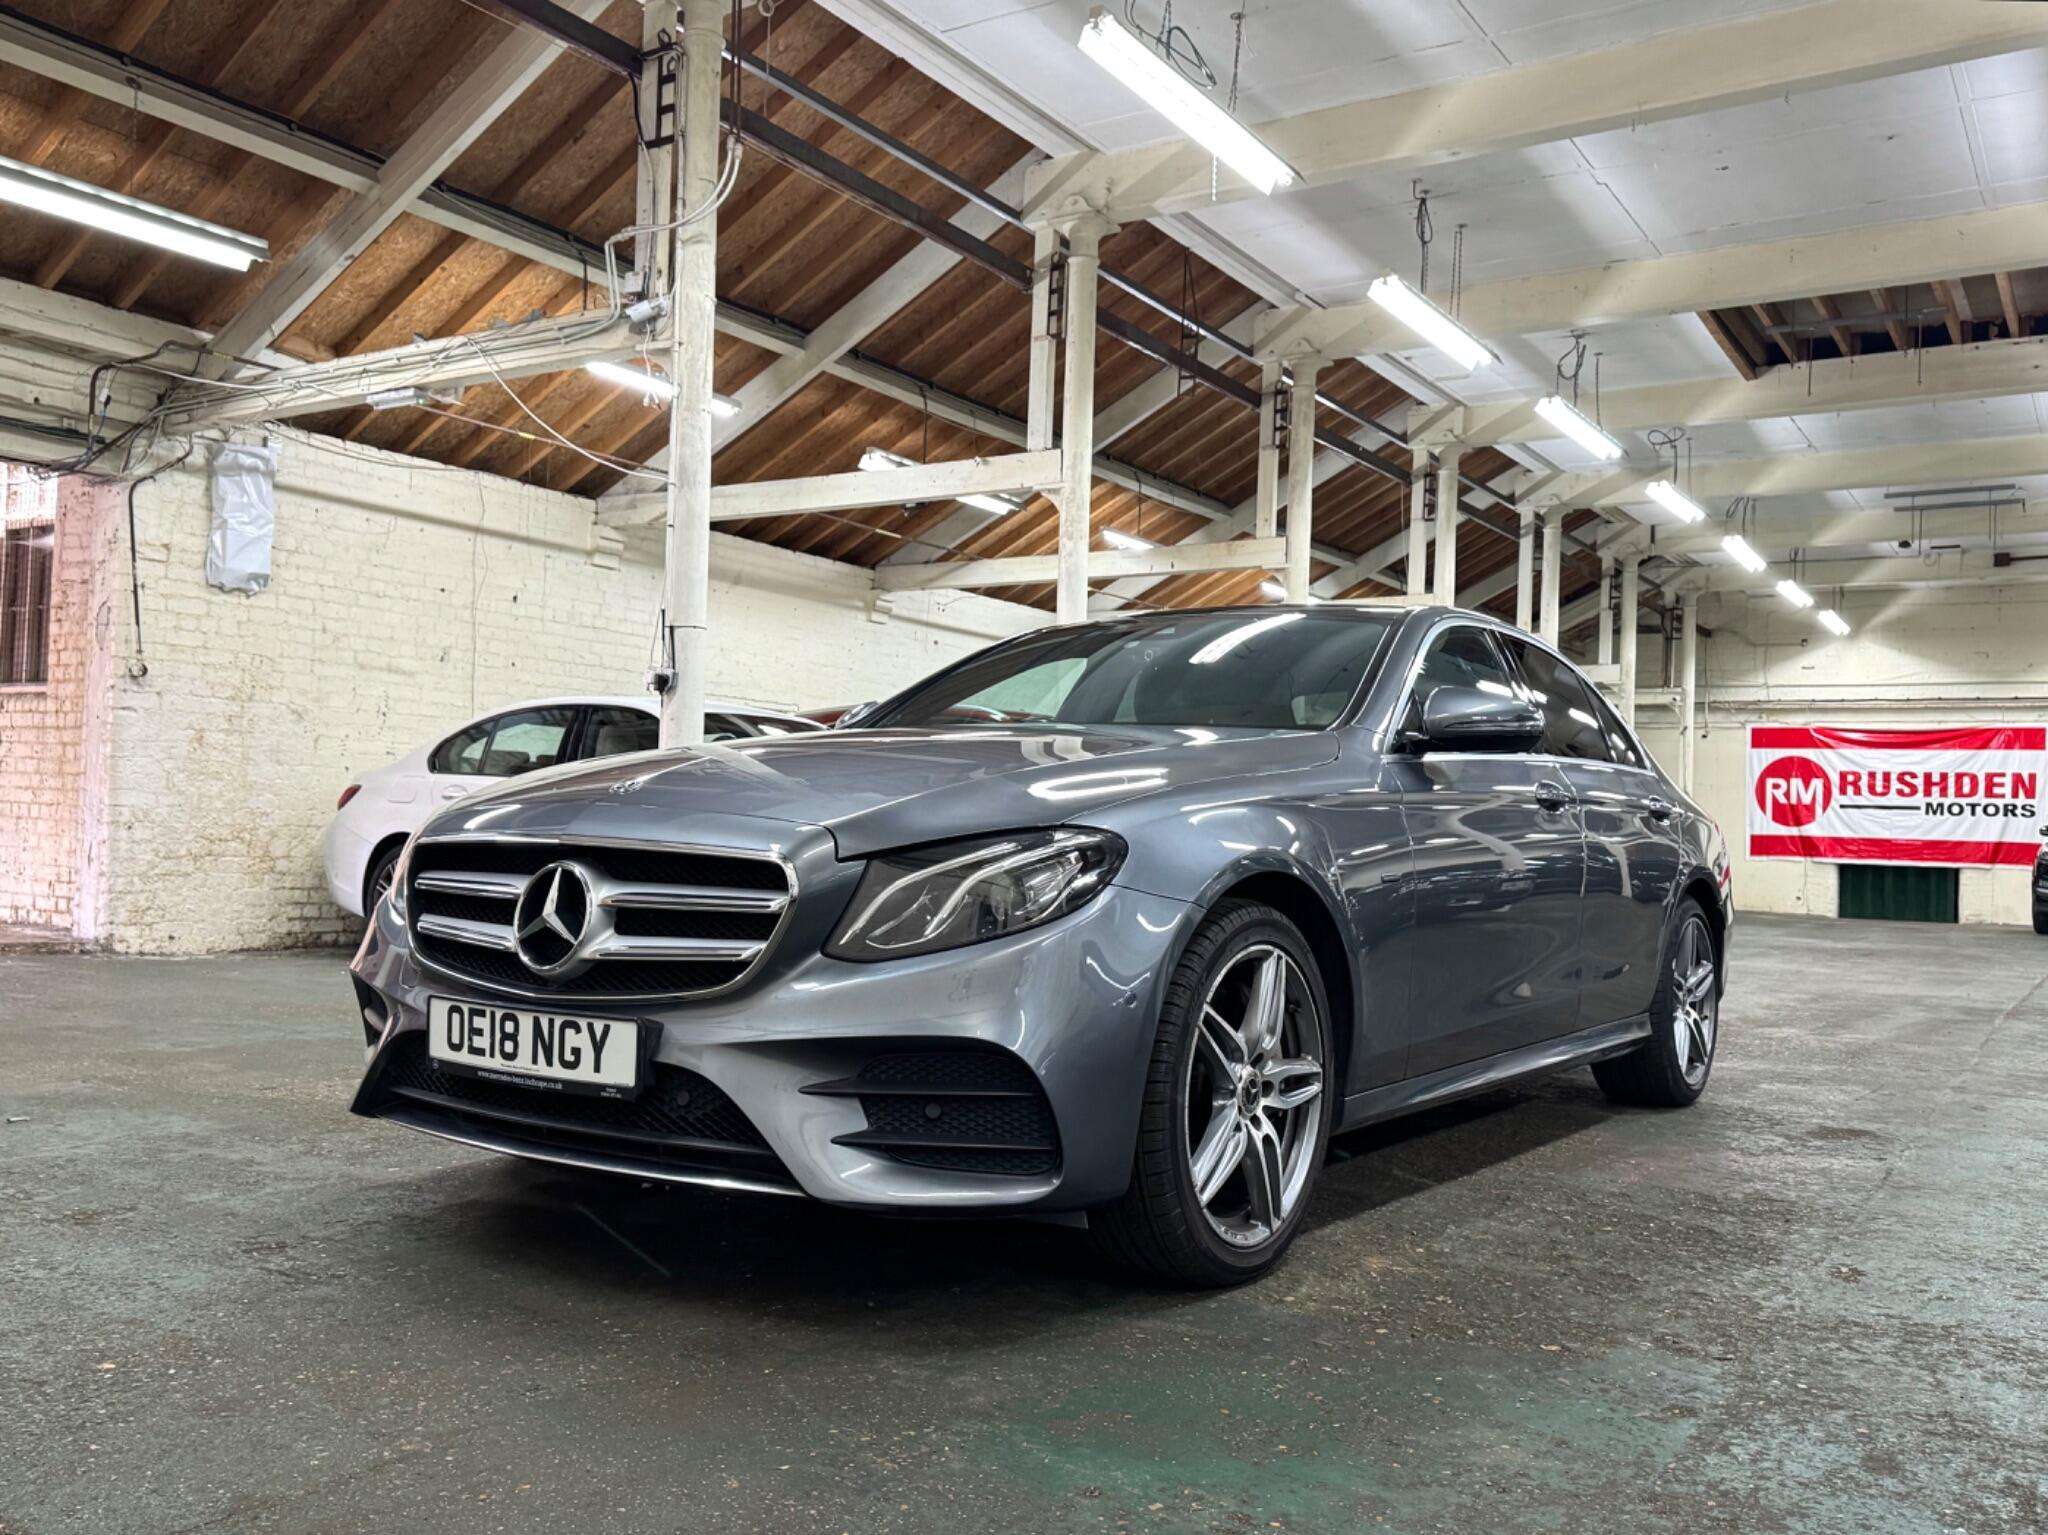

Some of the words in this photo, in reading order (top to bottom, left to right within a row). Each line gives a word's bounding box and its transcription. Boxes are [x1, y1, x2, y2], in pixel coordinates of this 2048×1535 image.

[1765, 777, 1824, 821] RM
[1839, 770, 2037, 800] RUSHDEN
[1924, 802, 2037, 819] MOTORS
[446, 1004, 520, 1062] OE18
[531, 1015, 611, 1074] NGY
